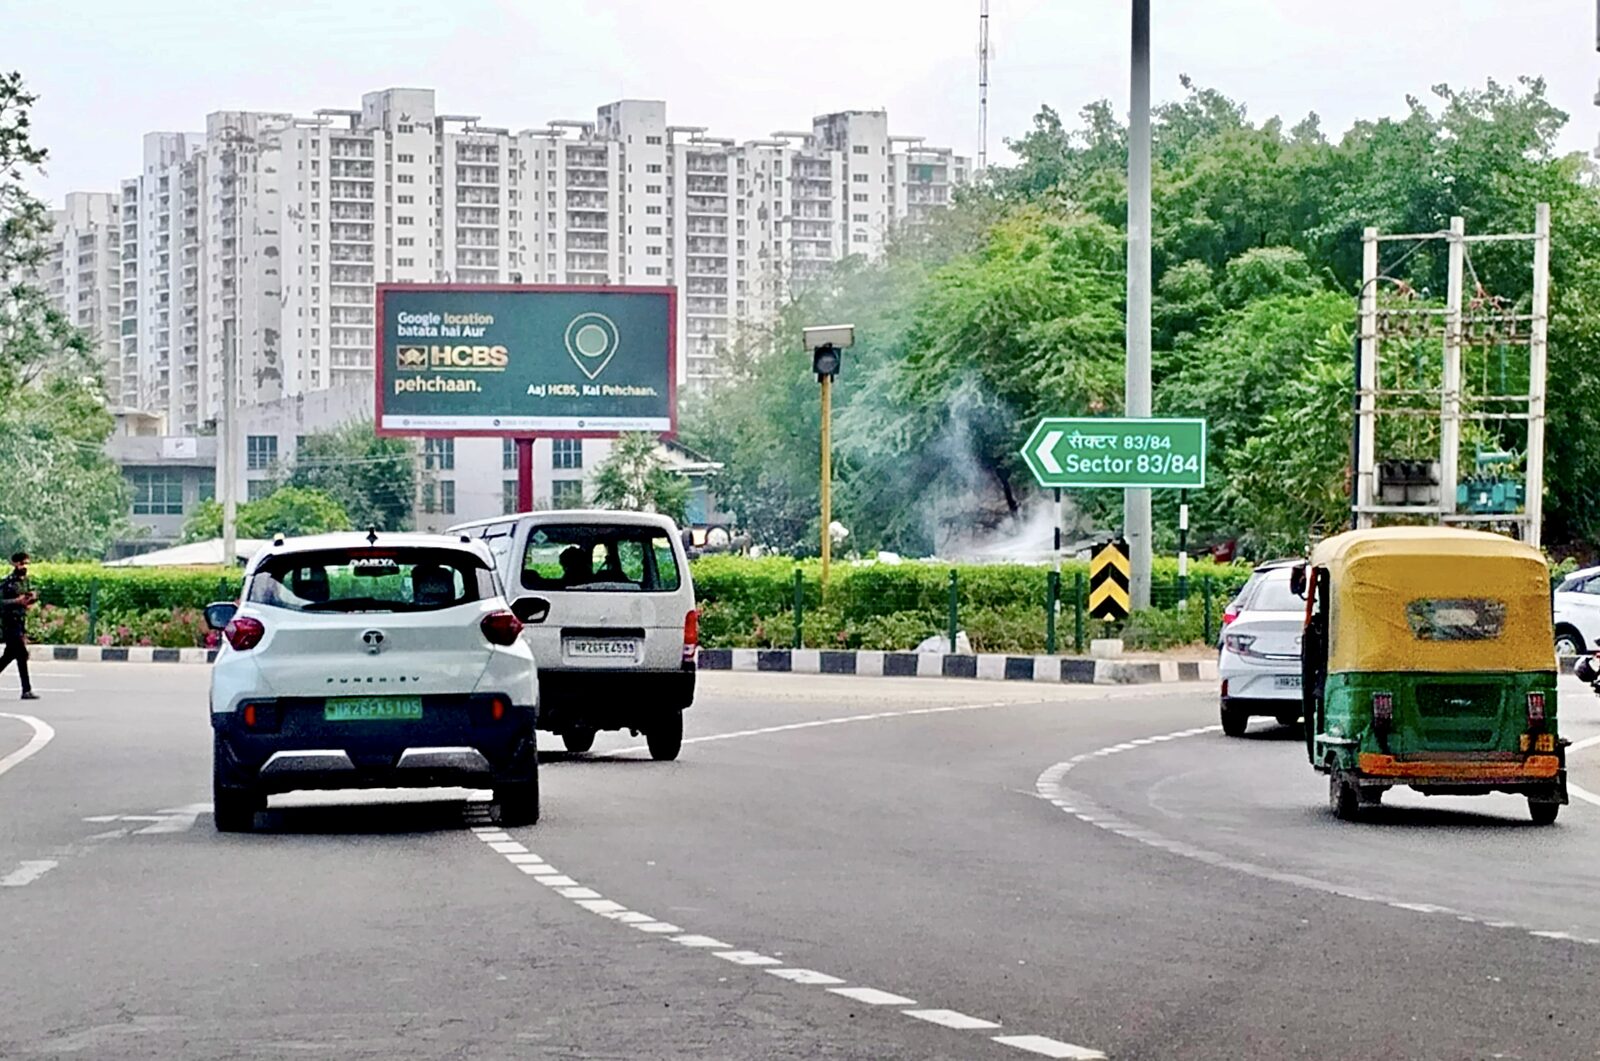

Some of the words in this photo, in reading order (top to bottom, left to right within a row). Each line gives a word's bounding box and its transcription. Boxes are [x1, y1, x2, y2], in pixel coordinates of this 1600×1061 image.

[397, 312, 440, 326] Google
[444, 311, 494, 325] location
[397, 325, 438, 338] batata
[441, 325, 461, 337] hai
[463, 326, 486, 338] Aur
[431, 346, 509, 366] HCBS
[395, 376, 482, 394] pehchaan.
[527, 384, 547, 398] Aaj
[548, 385, 580, 398] HCBS,
[582, 384, 600, 396] Kal
[602, 384, 658, 397] Pehchaan.
[1123, 435, 1171, 450] 83/84
[1066, 454, 1133, 473] Sector
[1136, 453, 1199, 475] 83/84
